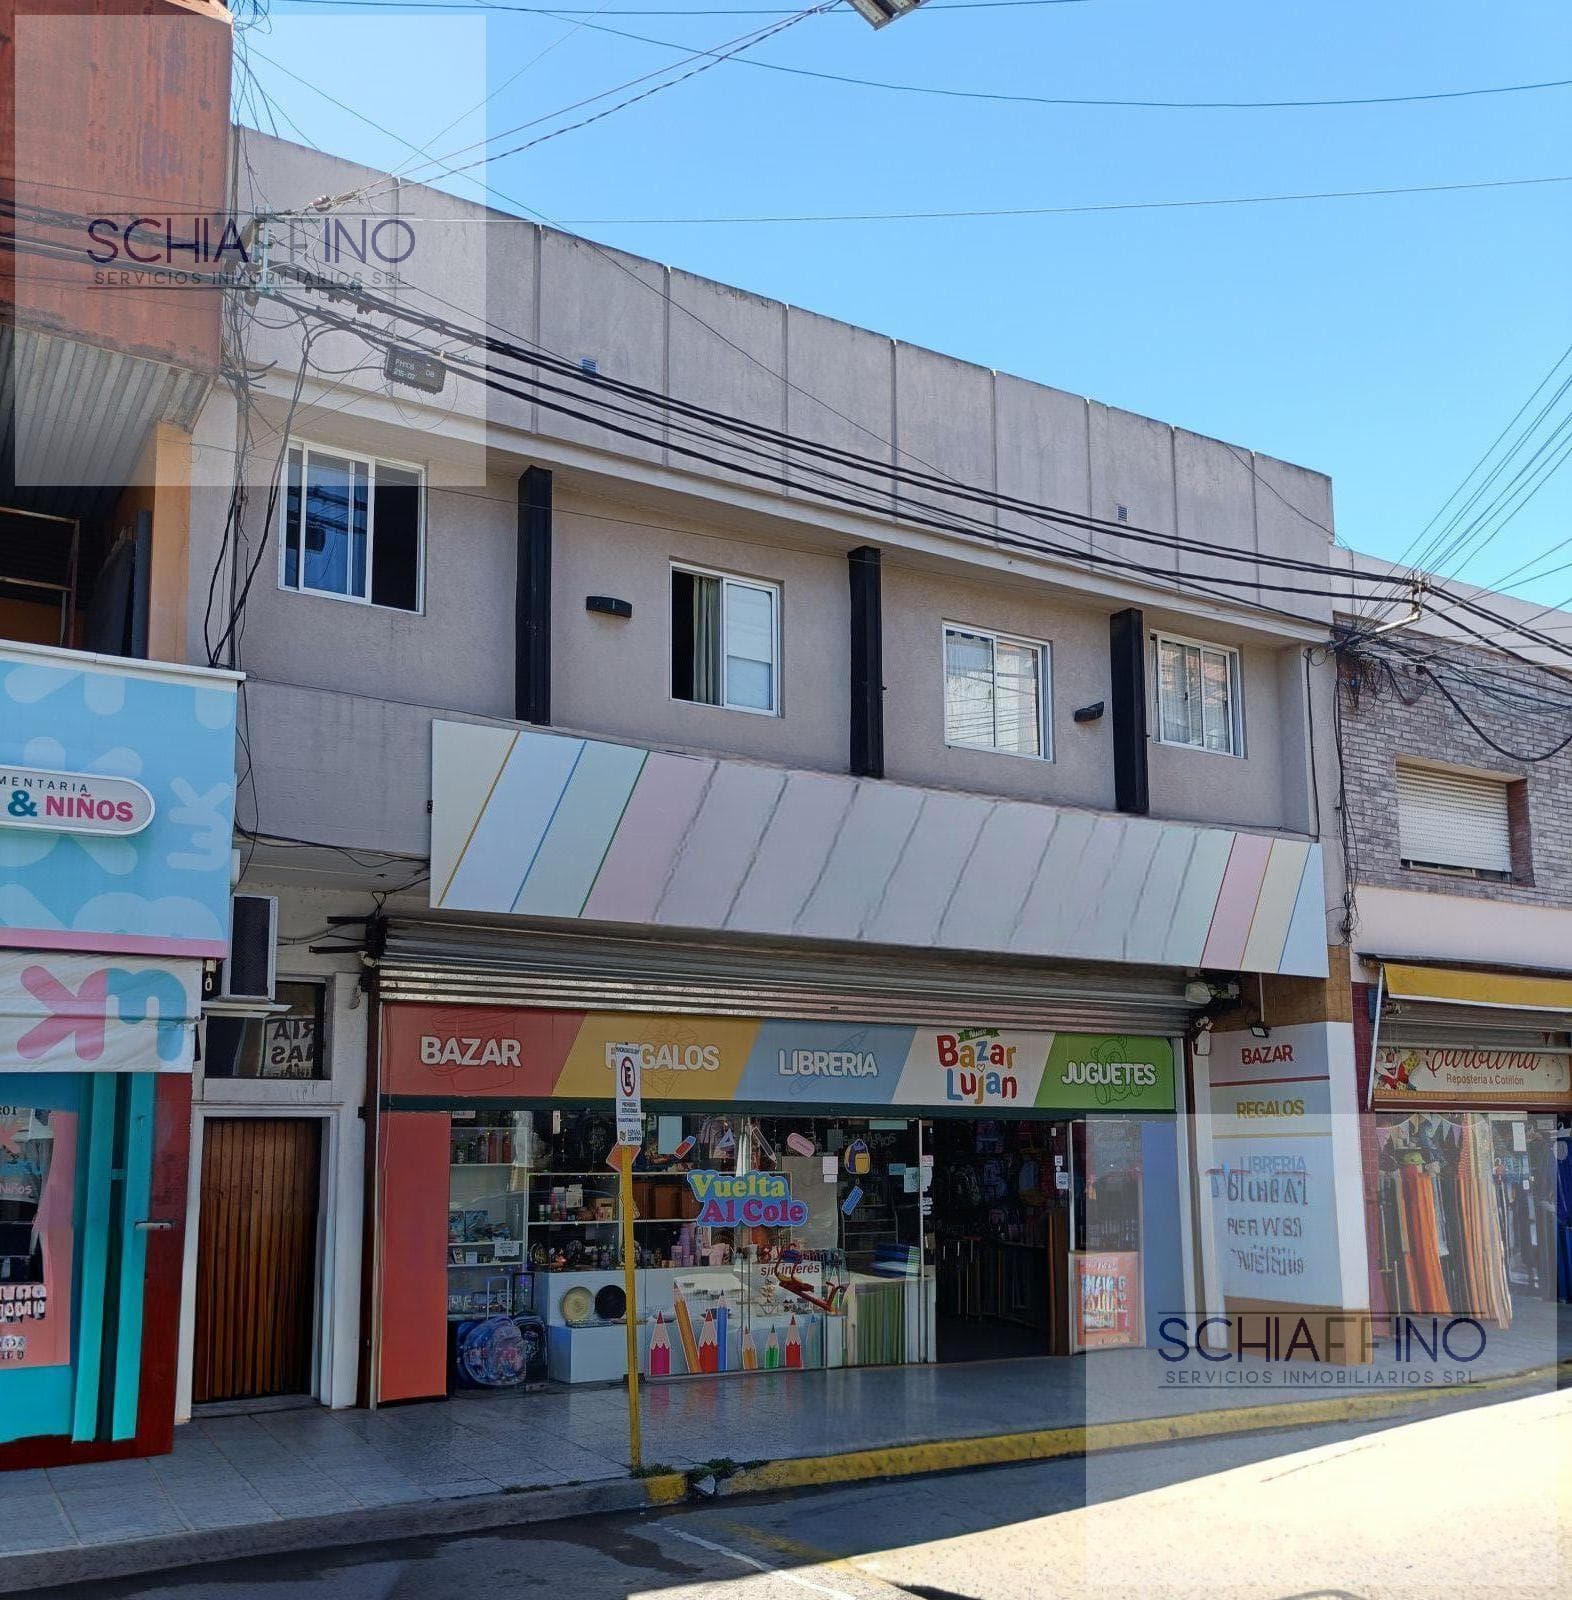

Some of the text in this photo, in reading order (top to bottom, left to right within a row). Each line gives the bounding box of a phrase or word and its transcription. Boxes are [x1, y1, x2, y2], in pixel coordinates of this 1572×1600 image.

[7, 789, 134, 823] & NIÑOS
[419, 1036, 521, 1068] BAZAR
[604, 1042, 720, 1071] RGALOS
[779, 1049, 879, 1077] LIBRERIA
[936, 1034, 1017, 1069] Bazar
[1241, 1045, 1294, 1065] BAZAR
[1061, 1061, 1157, 1086] JUGUETES
[1236, 1100, 1305, 1119] REGALOS
[691, 1175, 785, 1198] Vuelta
[703, 1200, 804, 1222] Al Cole
